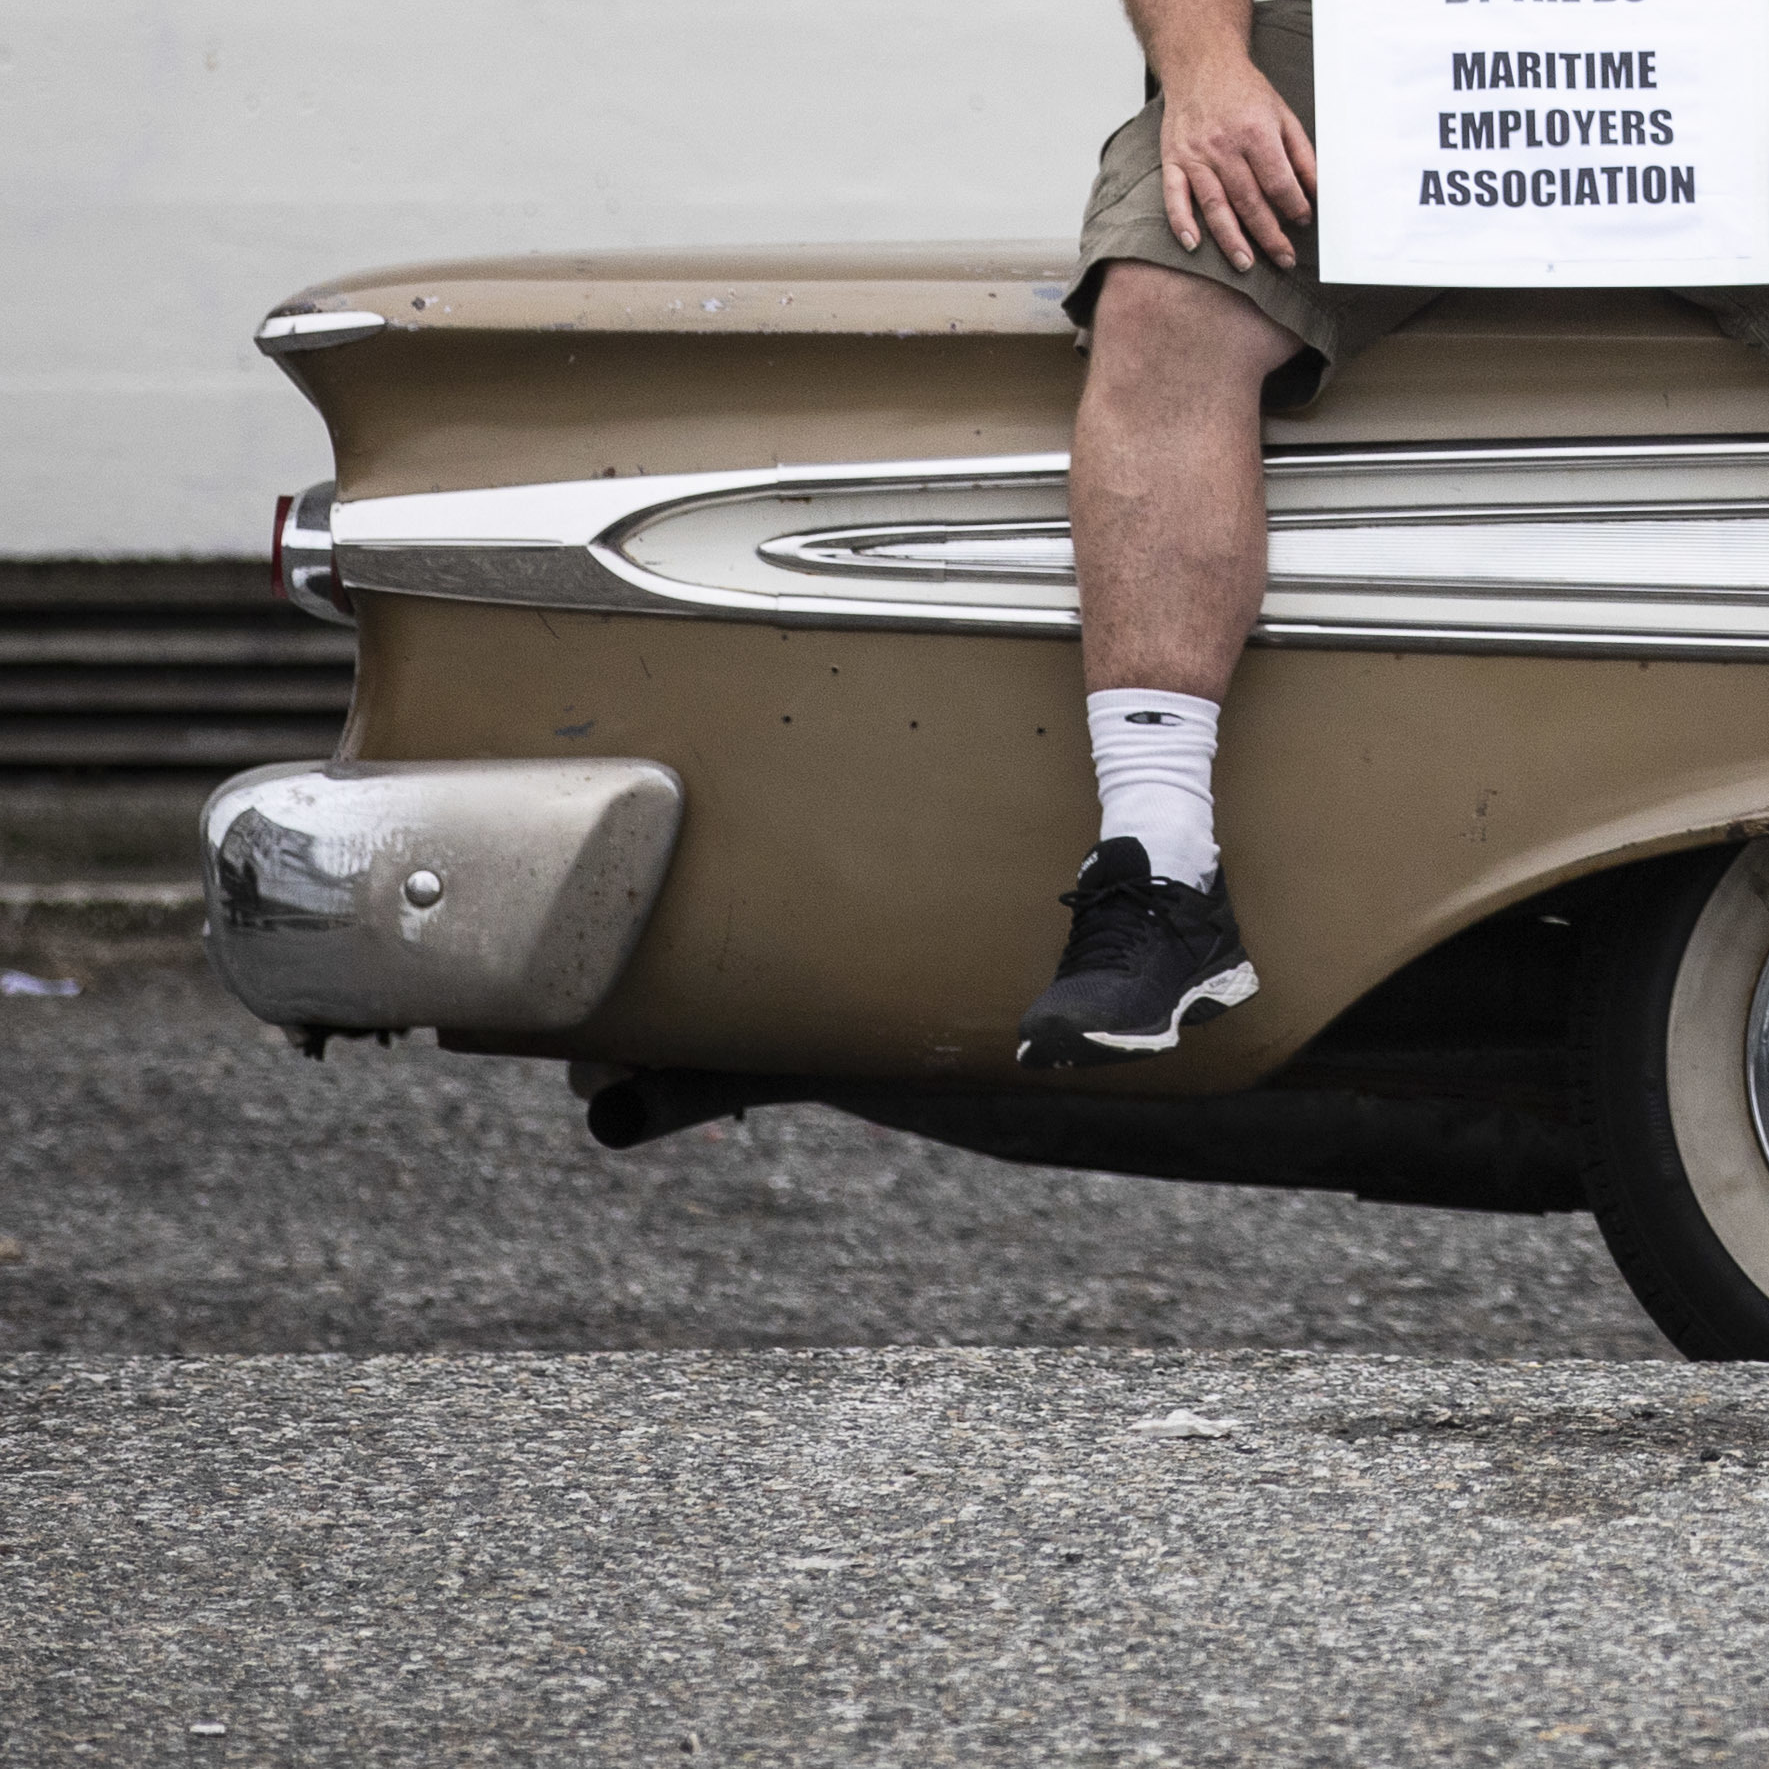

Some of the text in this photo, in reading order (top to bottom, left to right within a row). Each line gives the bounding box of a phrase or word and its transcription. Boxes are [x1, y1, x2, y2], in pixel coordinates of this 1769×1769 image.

[1452, 51, 1657, 91] MARITIME
[1439, 109, 1674, 150] EMPLOYERS
[1419, 165, 1695, 208] ASSOCIATION
